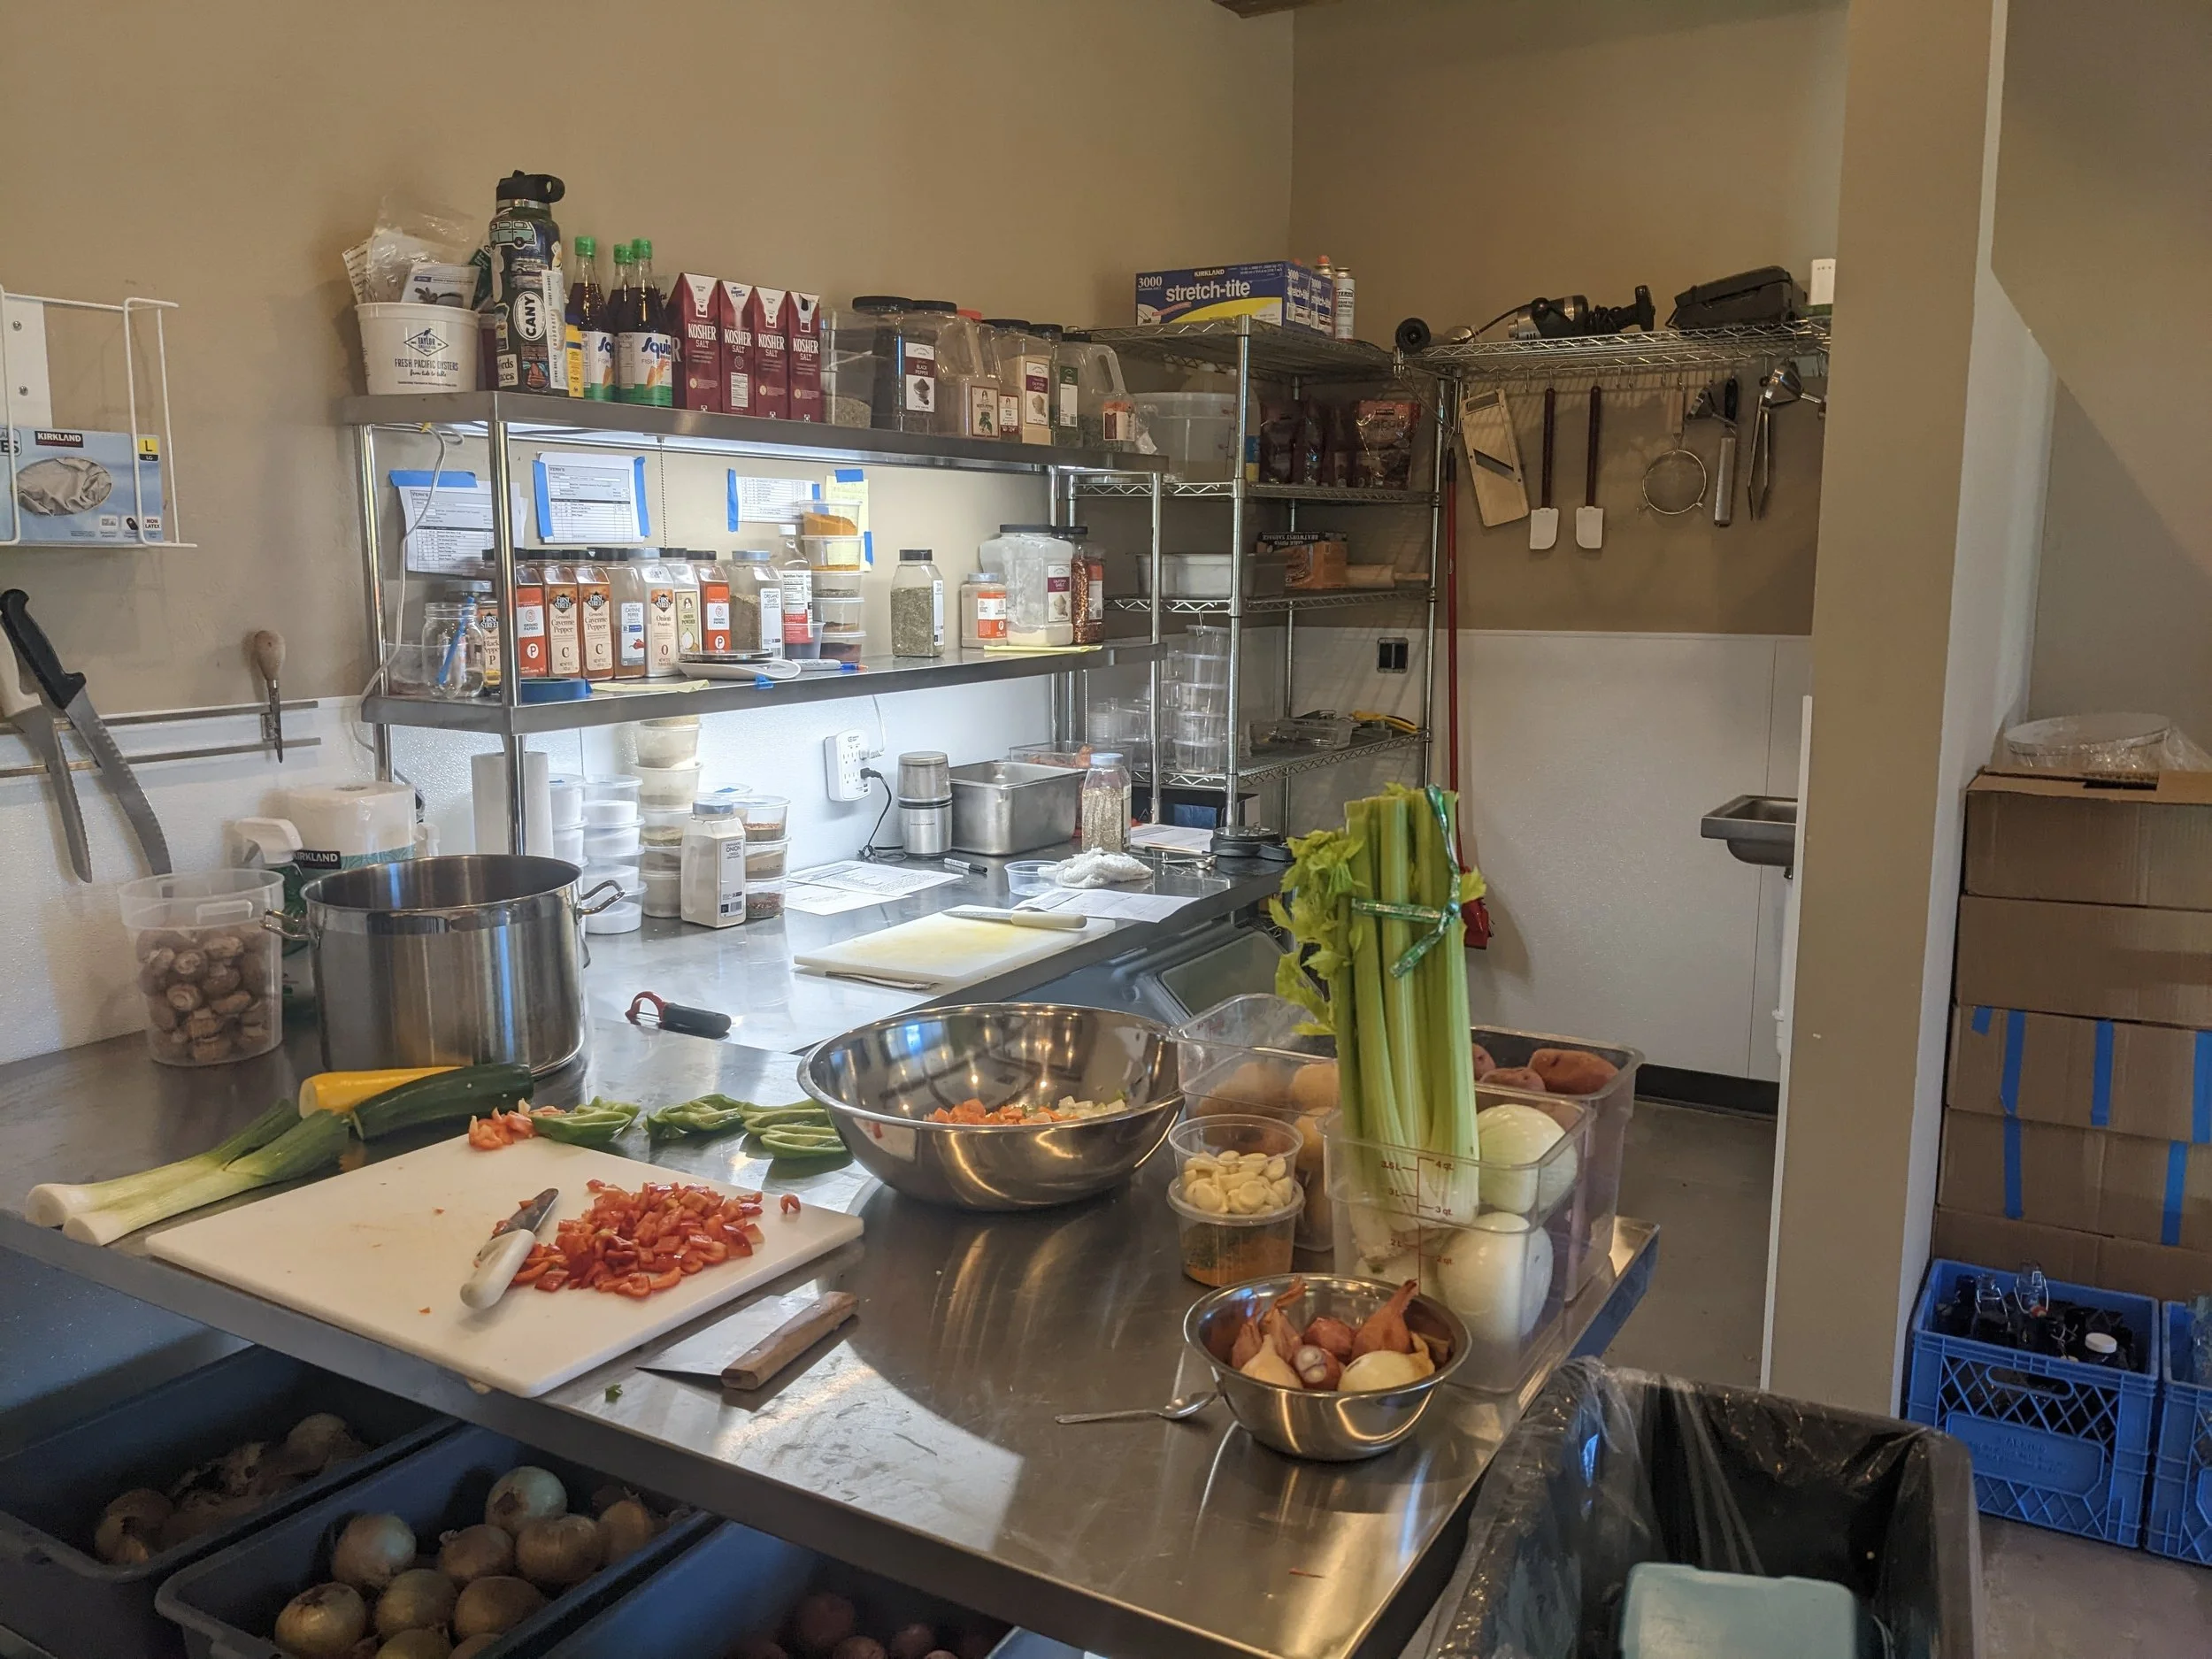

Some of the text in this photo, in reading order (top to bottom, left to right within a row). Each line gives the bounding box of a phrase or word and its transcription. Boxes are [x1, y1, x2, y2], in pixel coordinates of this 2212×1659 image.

[1194, 268, 1225, 277] KIRKLAND
[1138, 276, 1163, 288] 3000
[1165, 279, 1251, 303] stretch-tite
[524, 296, 537, 337] CANY
[688, 324, 717, 341] KOSHER
[724, 328, 752, 347] KOSHER
[418, 336, 436, 346] TAYLOR
[758, 334, 785, 350] KOSHER
[793, 338, 819, 354] KOSHER
[732, 345, 744, 354] SALT
[395, 358, 459, 372] FRESH PACIFIC OYSTERS
[37, 432, 81, 442] KIRKLAND
[144, 440, 153, 452] L
[718, 637, 723, 648] P
[531, 645, 537, 656] P
[562, 647, 570, 657] C
[595, 643, 603, 654] C
[489, 655, 496, 664] P
[294, 853, 337, 862] KIRKLAND
